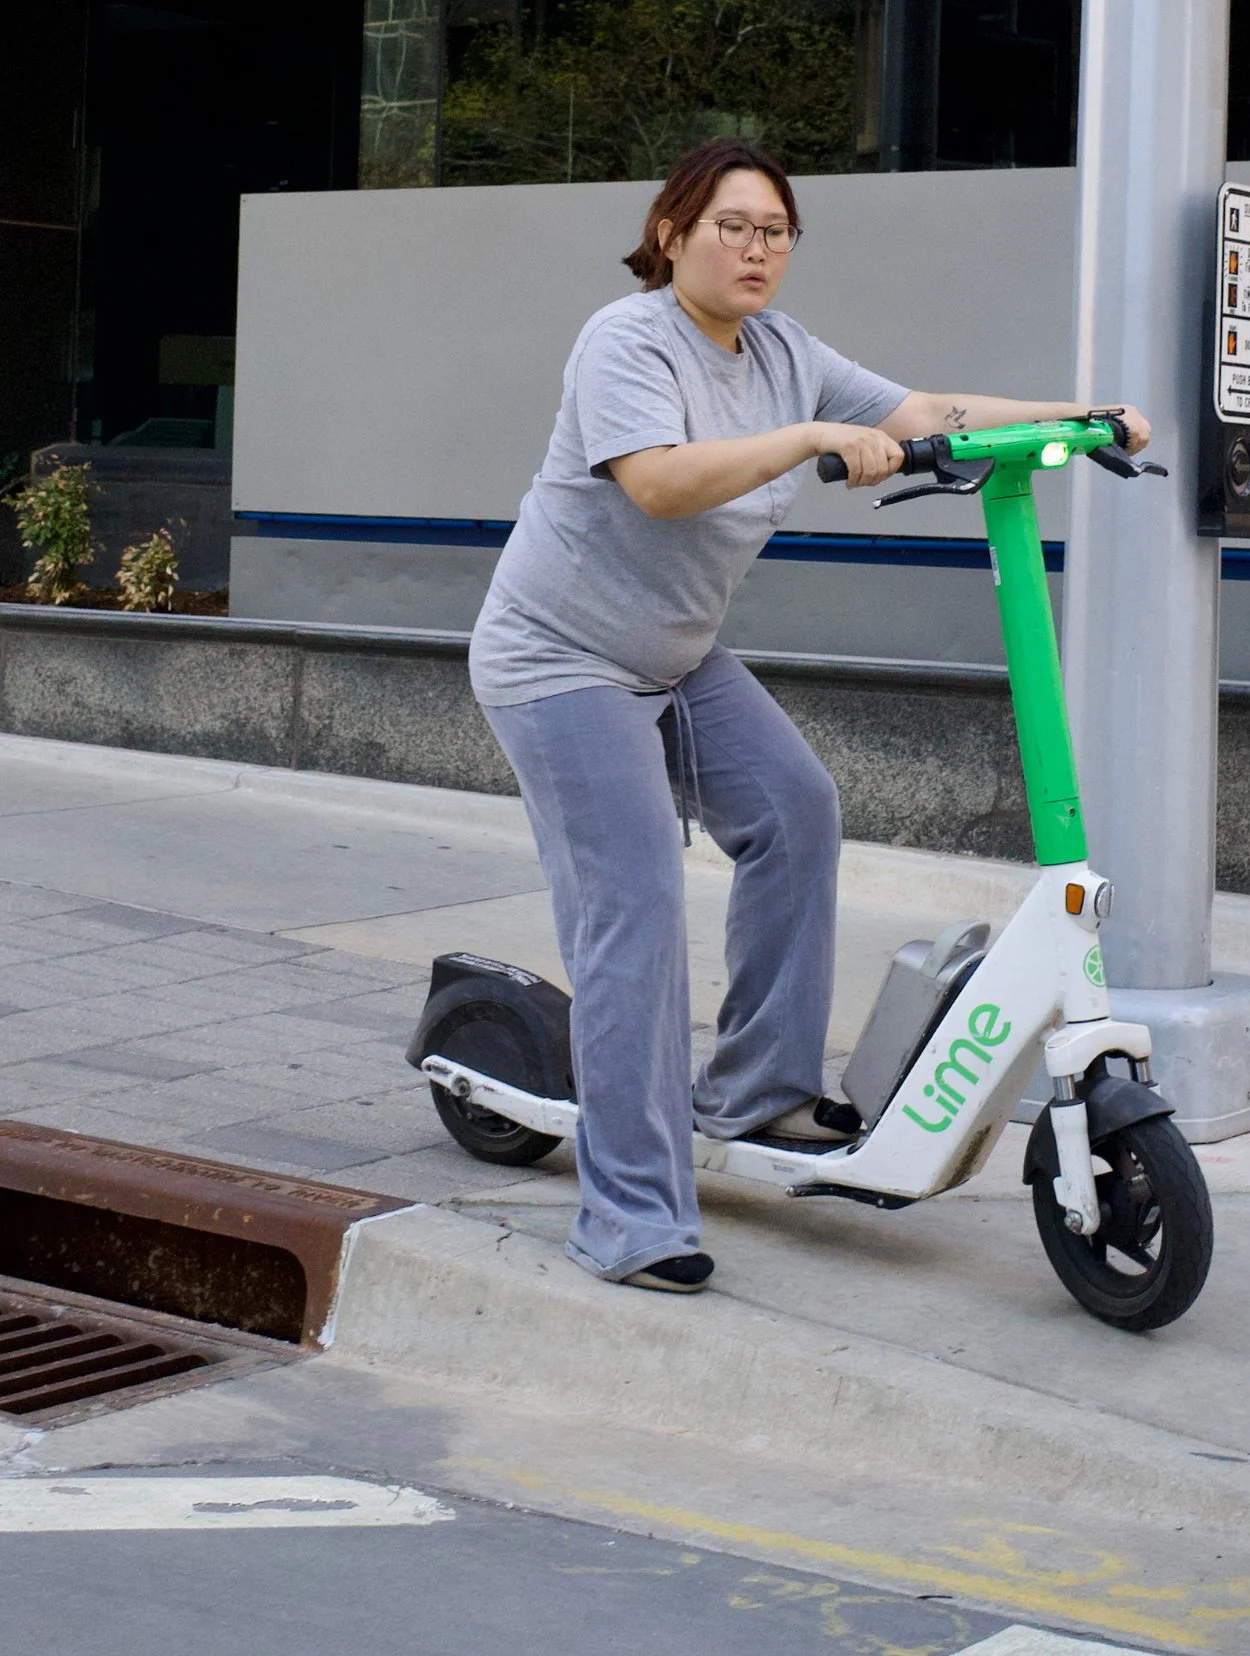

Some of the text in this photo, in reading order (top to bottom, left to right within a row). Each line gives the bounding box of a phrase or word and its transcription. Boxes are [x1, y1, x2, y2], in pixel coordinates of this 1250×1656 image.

[1232, 373, 1246, 385] PUSH
[1236, 396, 1243, 408] TO
[902, 1003, 1012, 1133] Lime
